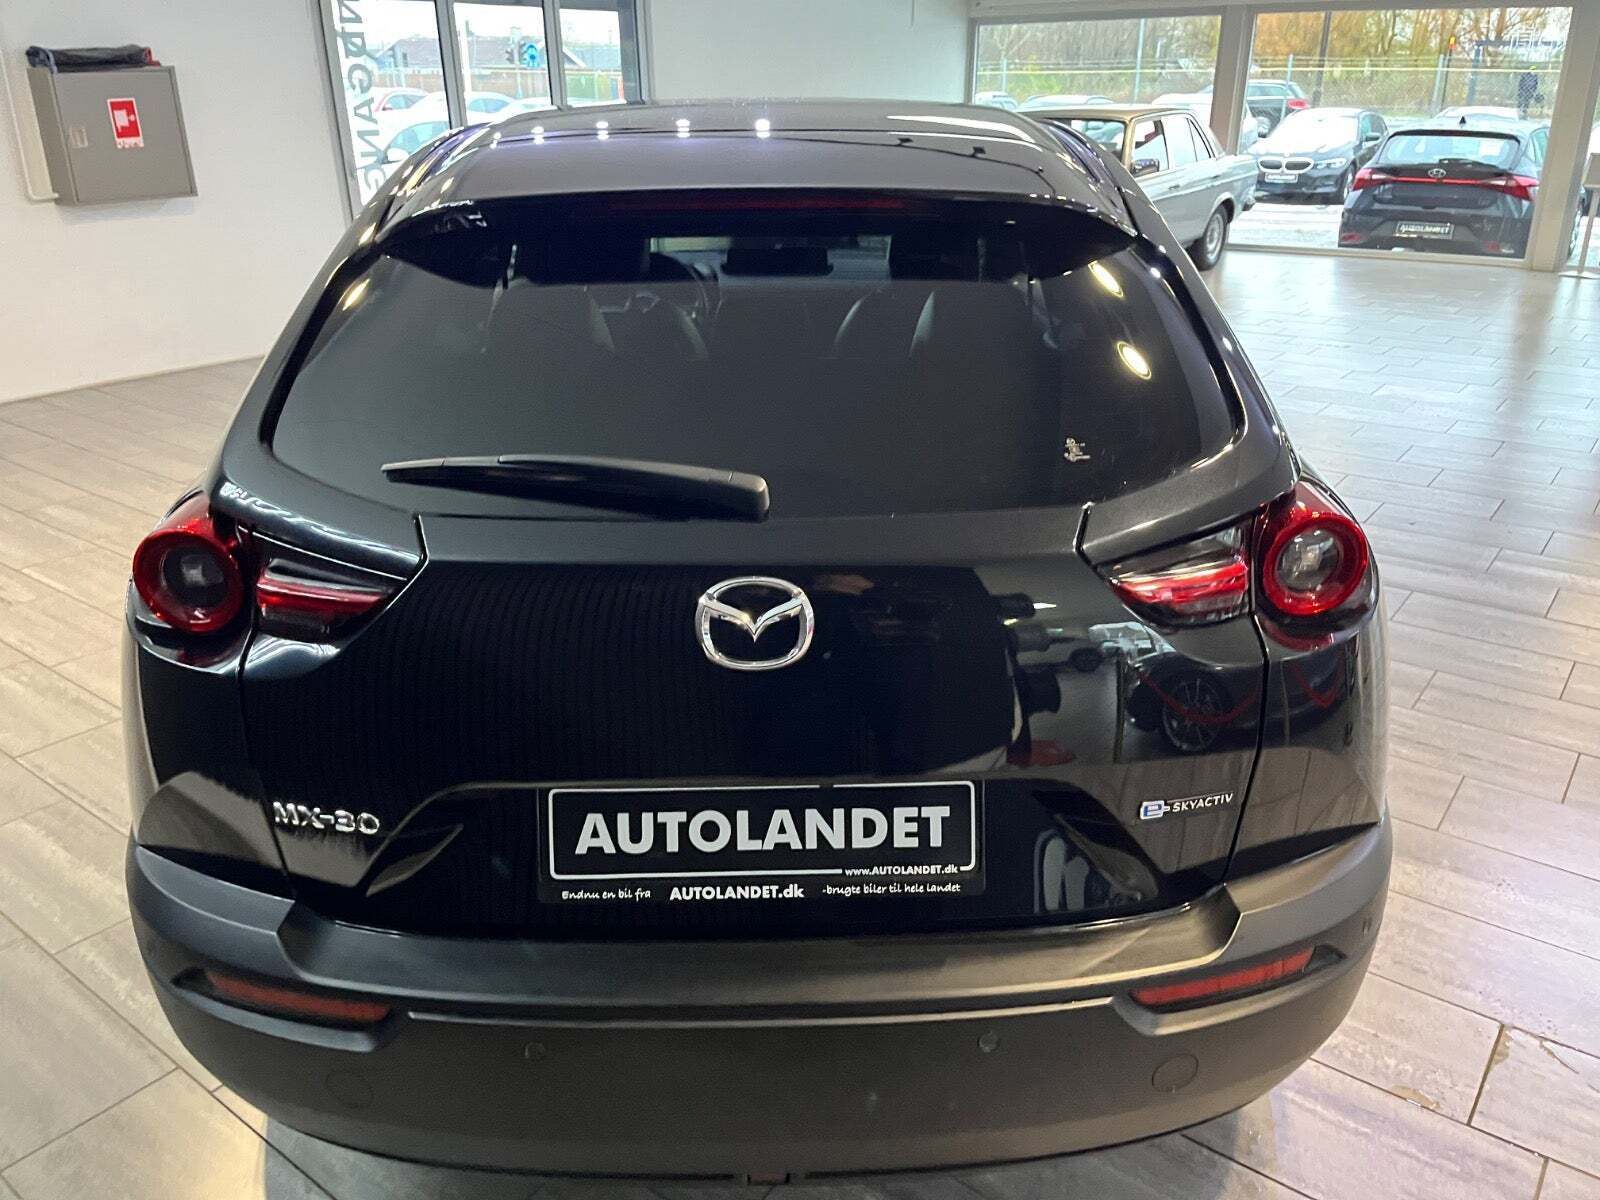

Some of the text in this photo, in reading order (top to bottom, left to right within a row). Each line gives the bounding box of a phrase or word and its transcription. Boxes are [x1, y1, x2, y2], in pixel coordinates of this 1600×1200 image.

[272, 801, 380, 834] MX-30
[575, 805, 951, 855] AUTOLANDET
[845, 864, 959, 876] www.AUTOLANDET.dk
[562, 888, 651, 901] Endnu en bil fra
[669, 884, 804, 900] AUTOLANDET.dk
[863, 883, 887, 894] biler
[889, 883, 902, 893] til
[904, 884, 924, 893] hele
[926, 883, 961, 893] landet
